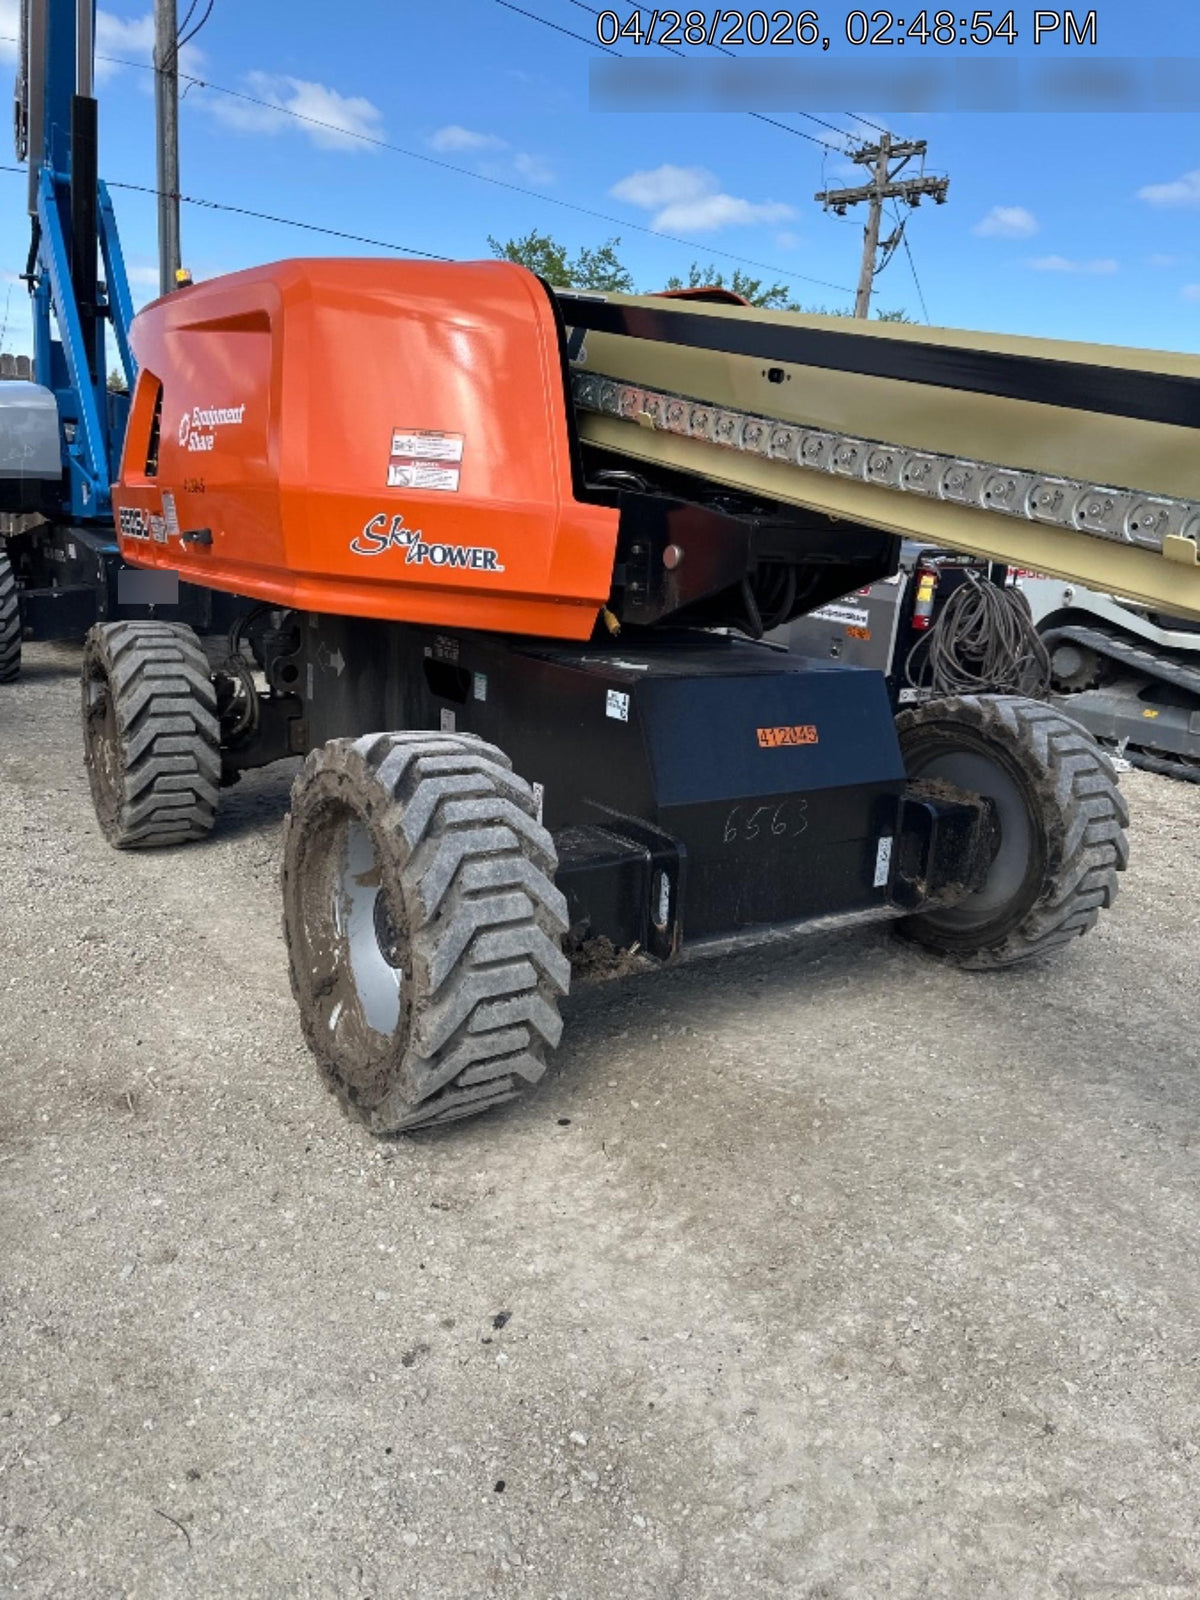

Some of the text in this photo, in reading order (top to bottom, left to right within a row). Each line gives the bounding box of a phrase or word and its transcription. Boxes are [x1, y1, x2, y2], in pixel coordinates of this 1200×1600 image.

[192, 403, 245, 430] Equipment
[188, 432, 214, 452] Share
[723, 800, 809, 843] 6563
